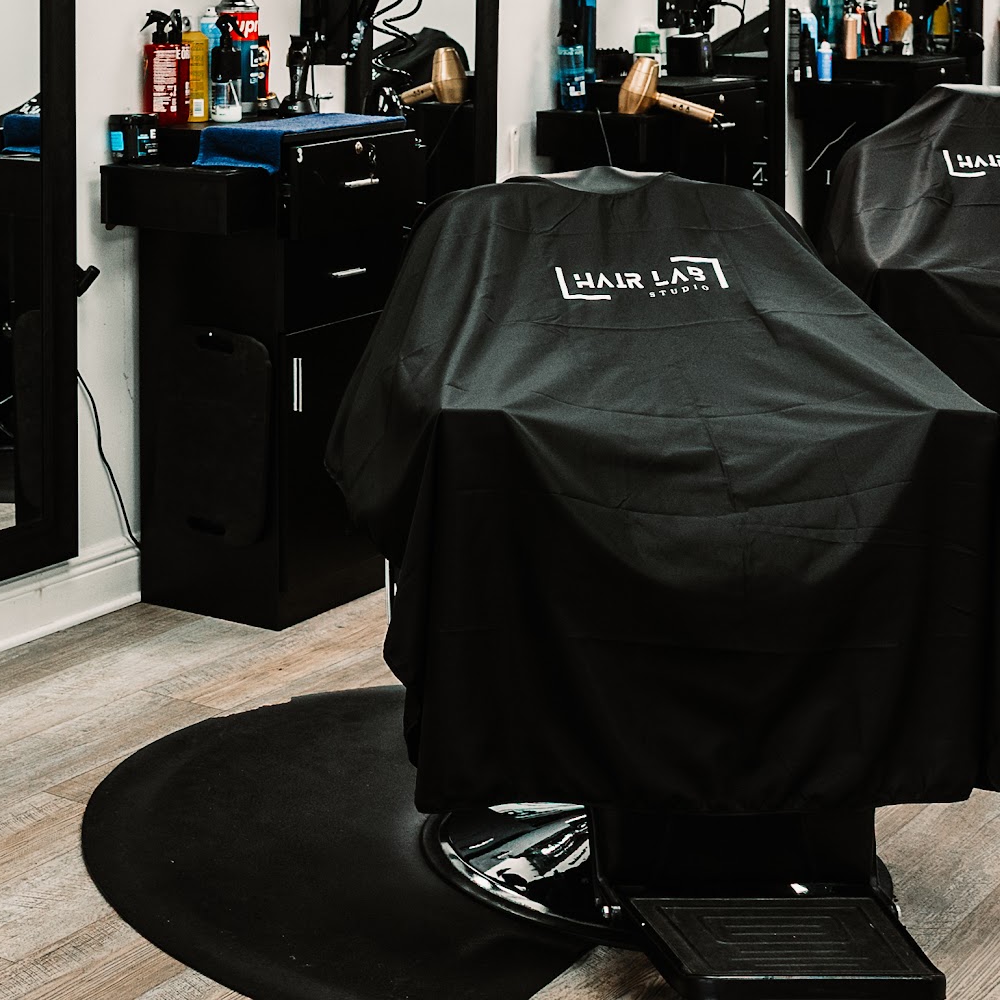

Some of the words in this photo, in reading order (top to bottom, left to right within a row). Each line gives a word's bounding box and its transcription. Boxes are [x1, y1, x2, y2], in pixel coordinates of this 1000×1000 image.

[572, 271, 645, 289] HAIR
[651, 266, 707, 287] LAB
[648, 284, 710, 298] STUDIO
